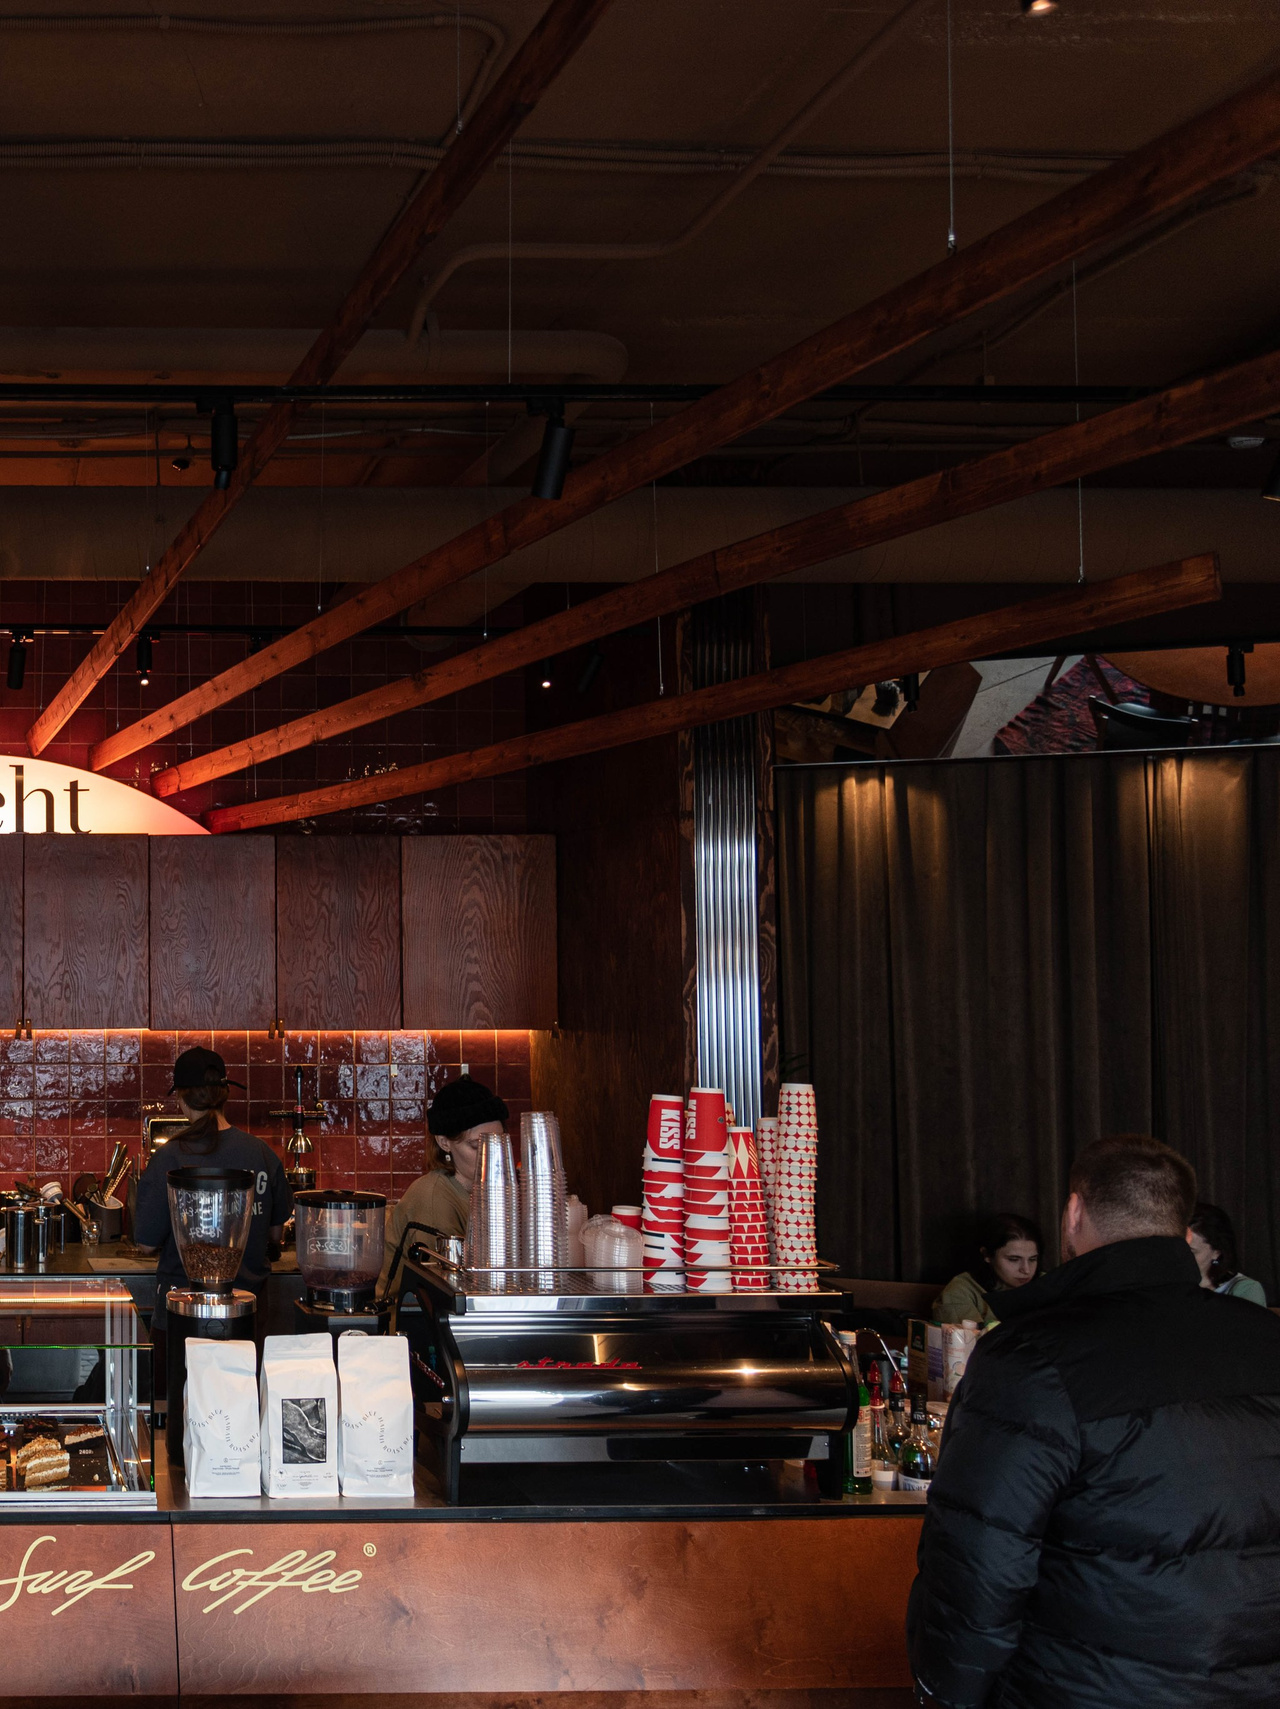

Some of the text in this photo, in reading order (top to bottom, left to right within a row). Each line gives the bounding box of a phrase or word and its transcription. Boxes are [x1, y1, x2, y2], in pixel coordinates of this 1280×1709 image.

[659, 1108, 680, 1150] KISS
[515, 1357, 642, 1369] strada
[182, 1549, 363, 1615] Coffee
